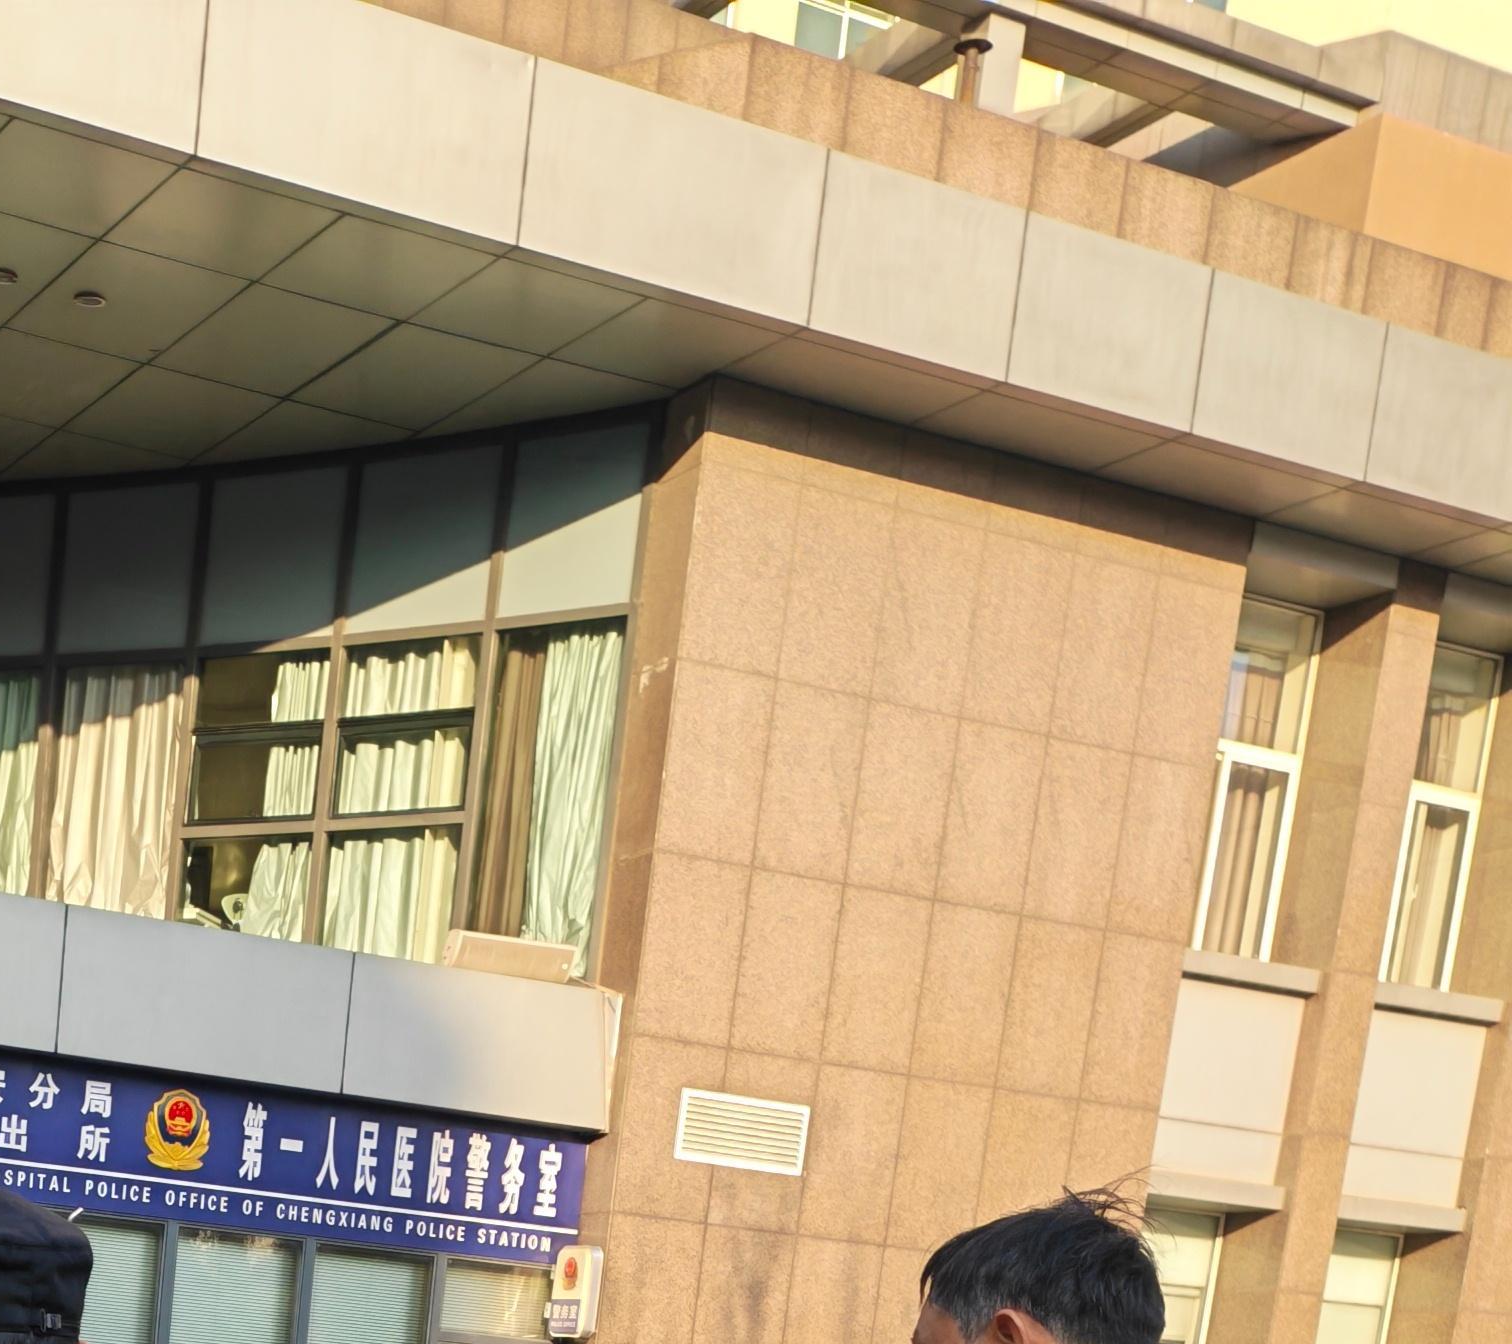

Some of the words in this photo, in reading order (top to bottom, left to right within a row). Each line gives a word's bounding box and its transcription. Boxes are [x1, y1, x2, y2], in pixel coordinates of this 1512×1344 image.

[237, 1101, 563, 1218] 第一人民医院警务室
[84, 1180, 151, 1203] POLICE
[164, 1189, 229, 1213] OFFICE
[242, 1200, 265, 1217] OF
[276, 1203, 394, 1233] CHENGXIANG
[405, 1219, 466, 1243] POLICE
[477, 1227, 552, 1253] STATION
